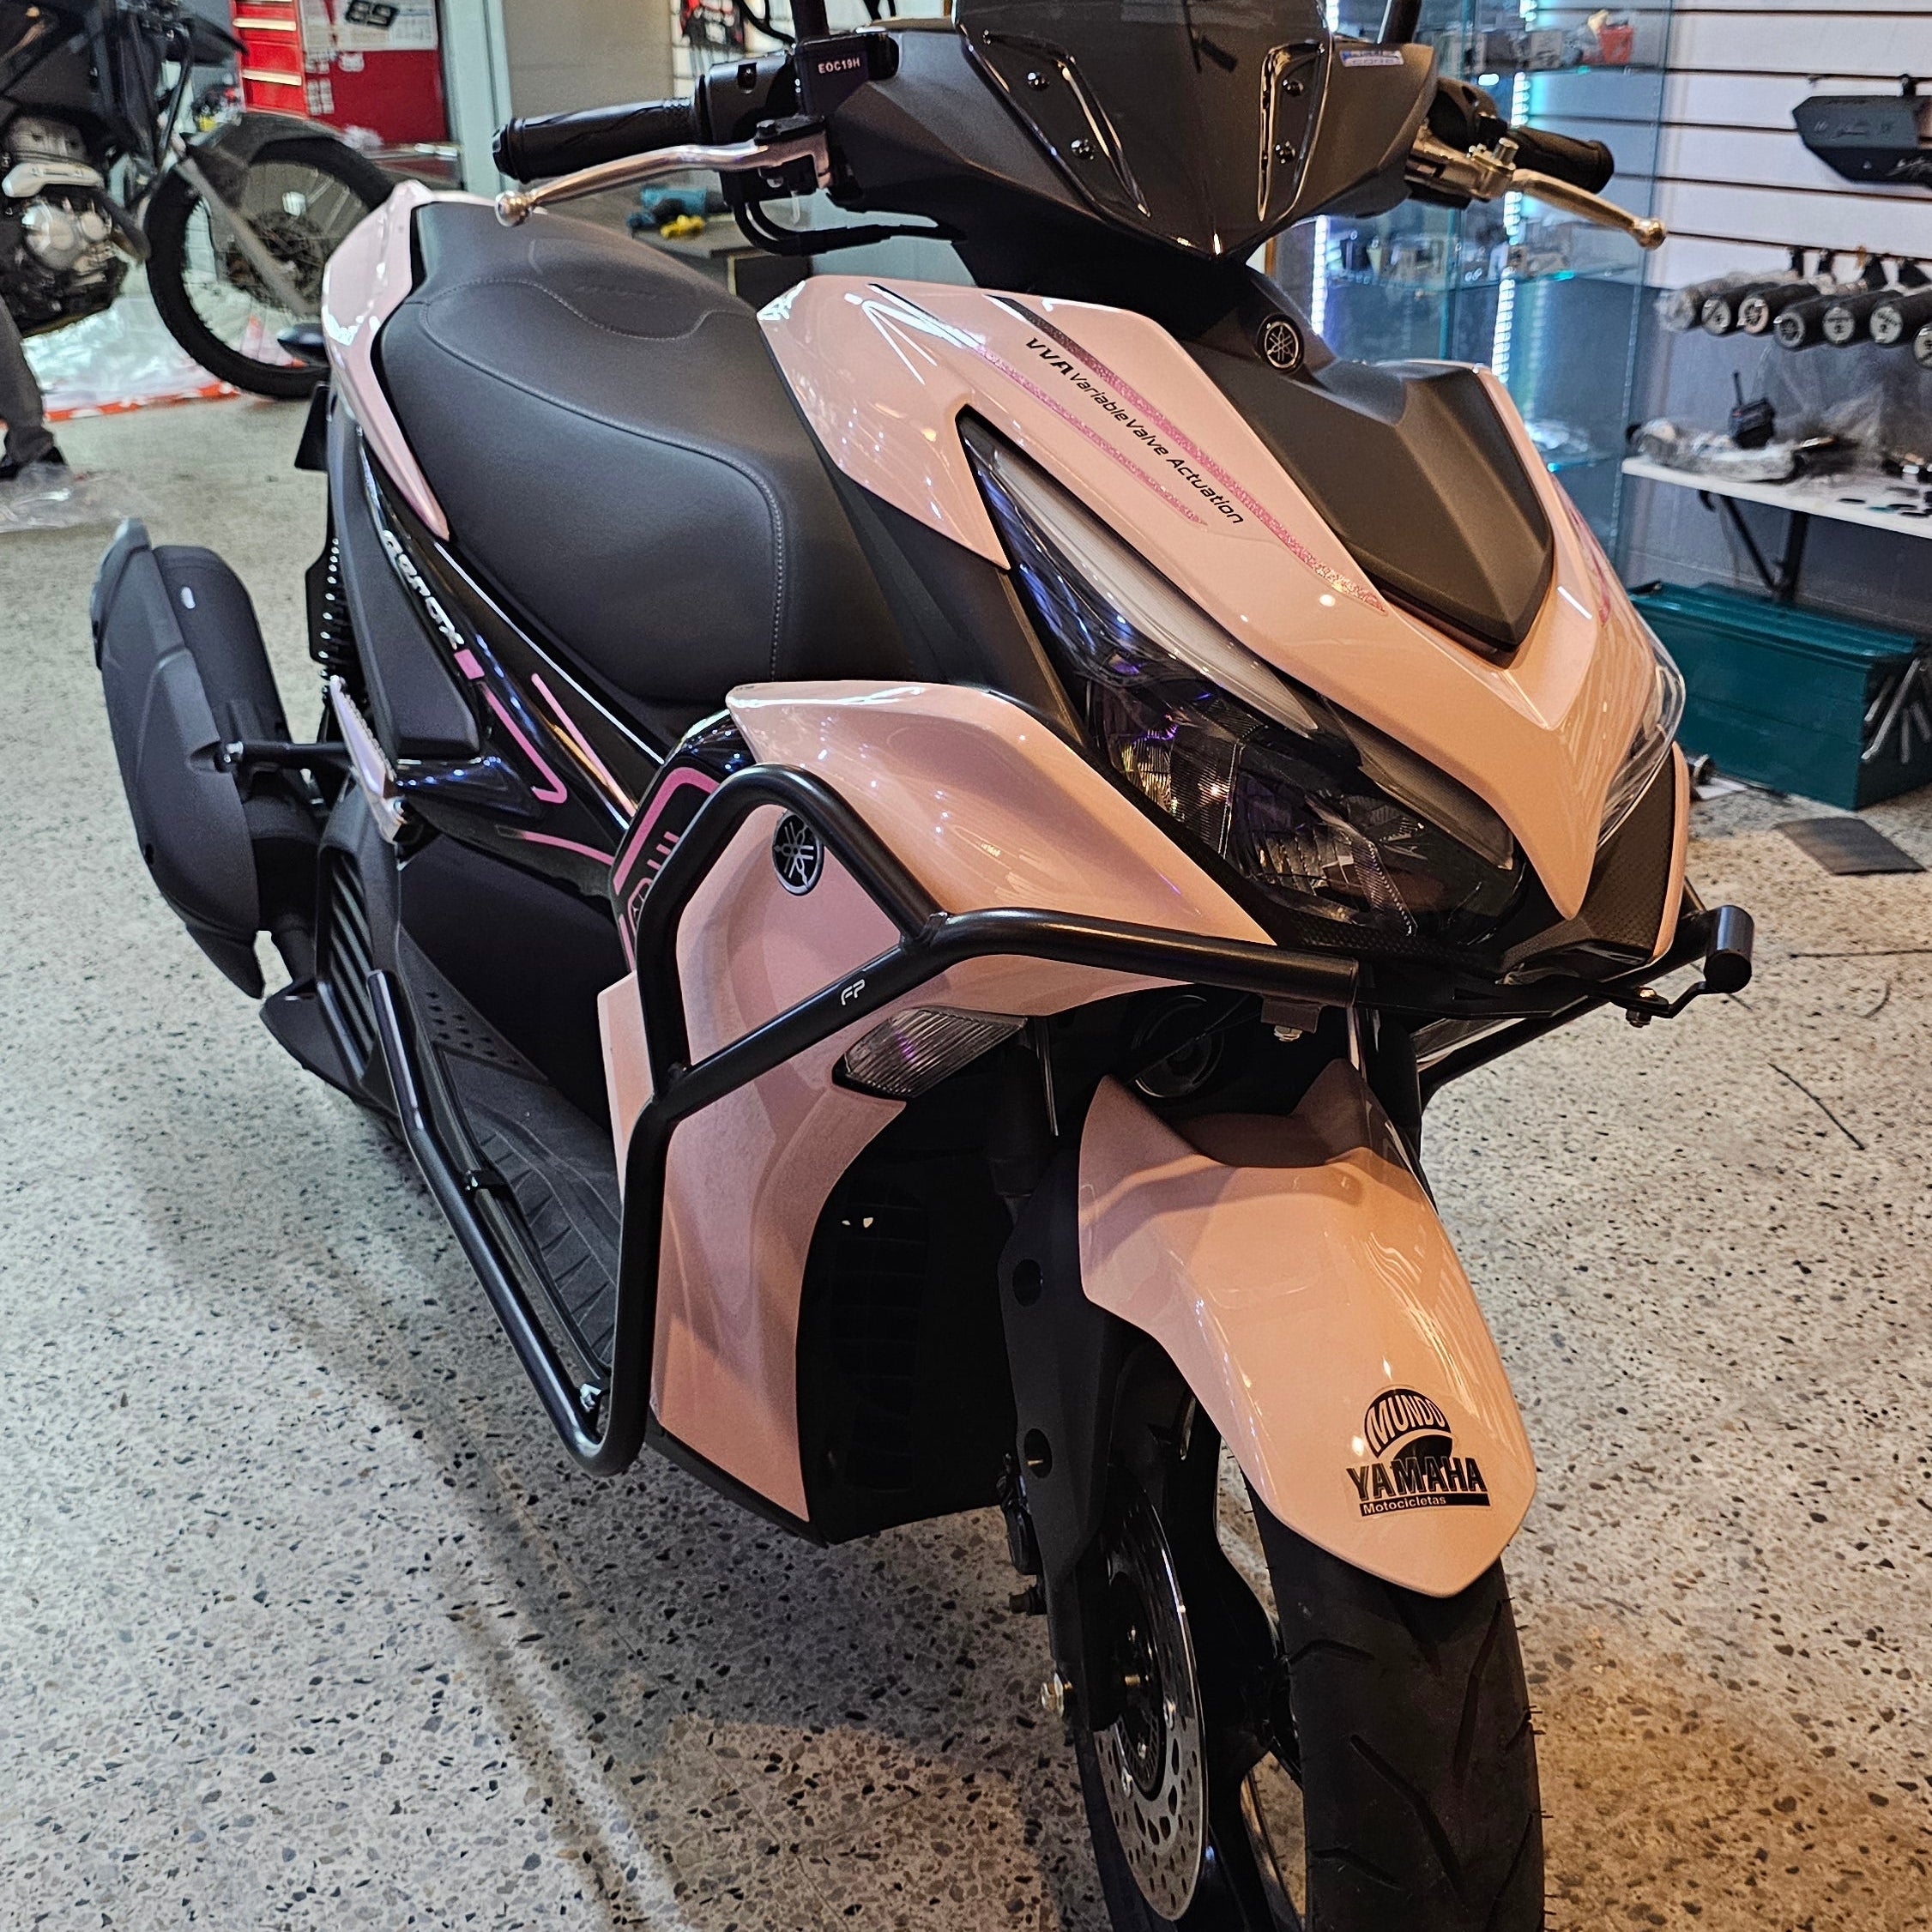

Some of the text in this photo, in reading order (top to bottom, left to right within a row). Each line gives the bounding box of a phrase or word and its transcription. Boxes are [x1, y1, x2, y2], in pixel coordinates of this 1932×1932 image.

[818, 57, 860, 75] EOC19H
[1025, 337, 1244, 524] VVA Variable Valve Actuation
[841, 979, 866, 1005] FP
[1366, 1394, 1446, 1453] MUNDO
[1346, 1456, 1488, 1501] YAMAHA
[1362, 1495, 1447, 1515] Motocicletas
